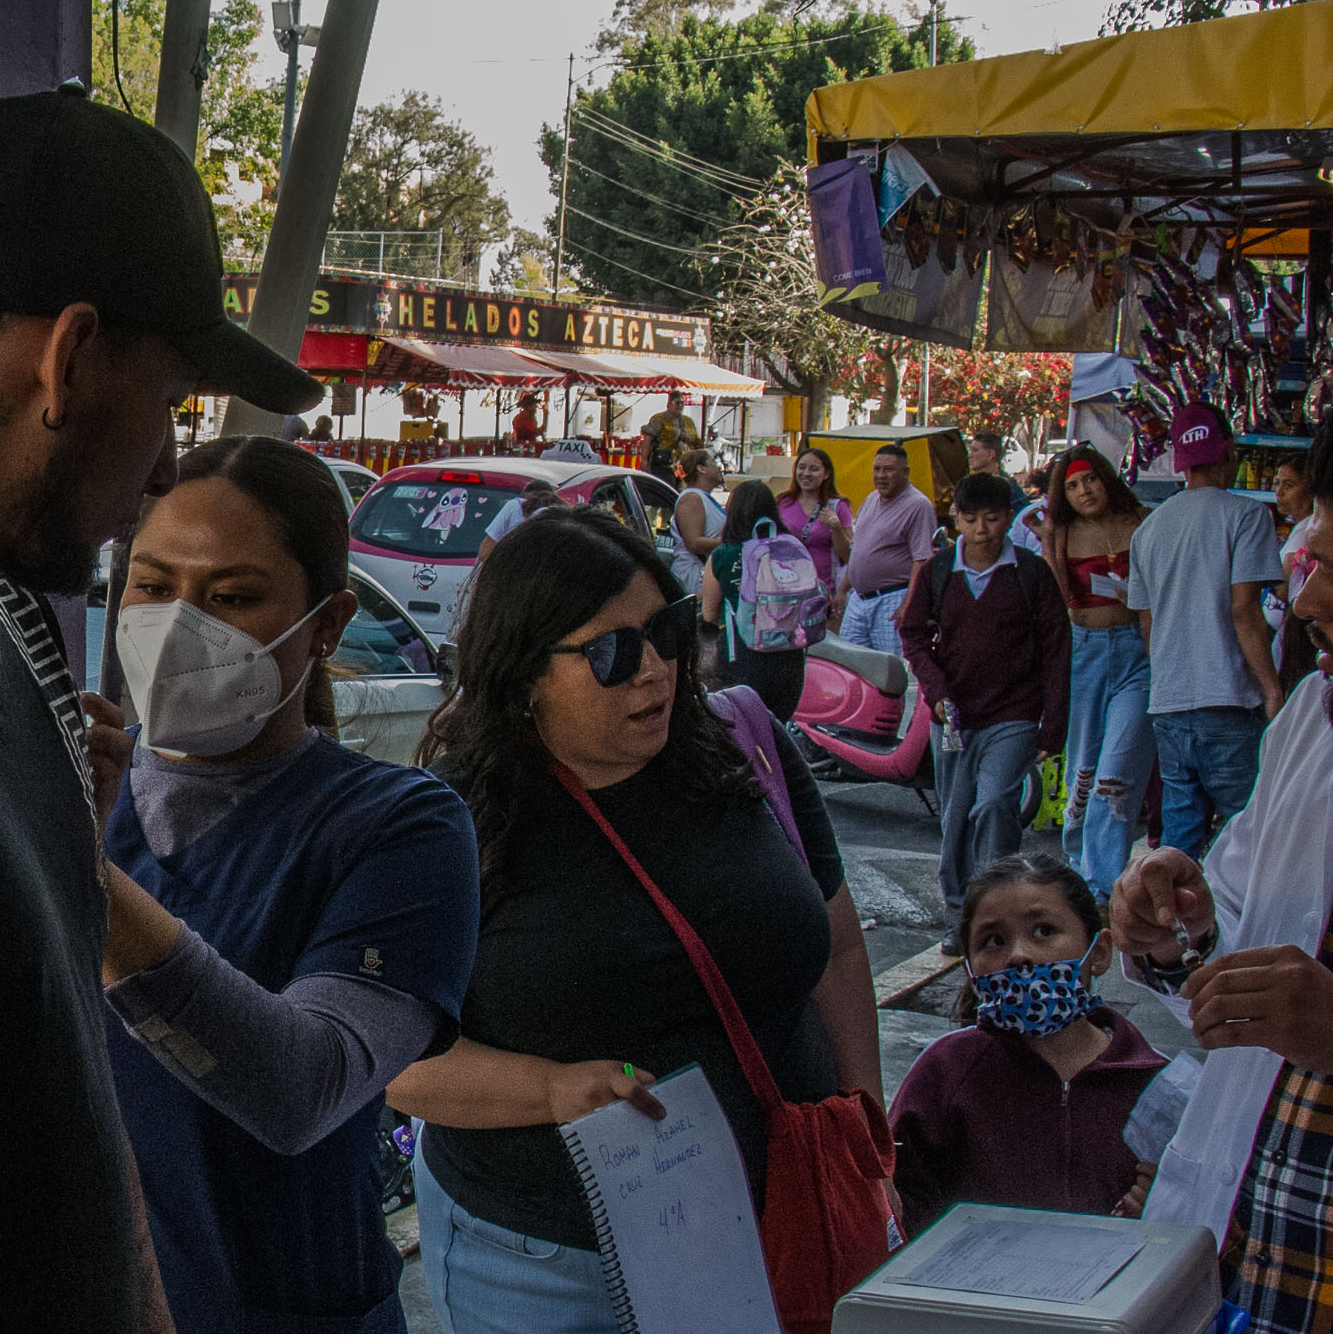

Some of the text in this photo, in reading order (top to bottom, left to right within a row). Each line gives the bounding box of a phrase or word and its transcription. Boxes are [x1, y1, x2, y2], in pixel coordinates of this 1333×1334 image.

[833, 270, 853, 282] COME
[399, 293, 655, 351] HELADOS AZTECA
[1182, 429, 1204, 444] LTH
[558, 443, 584, 452] TAXI
[236, 686, 266, 699] KN95
